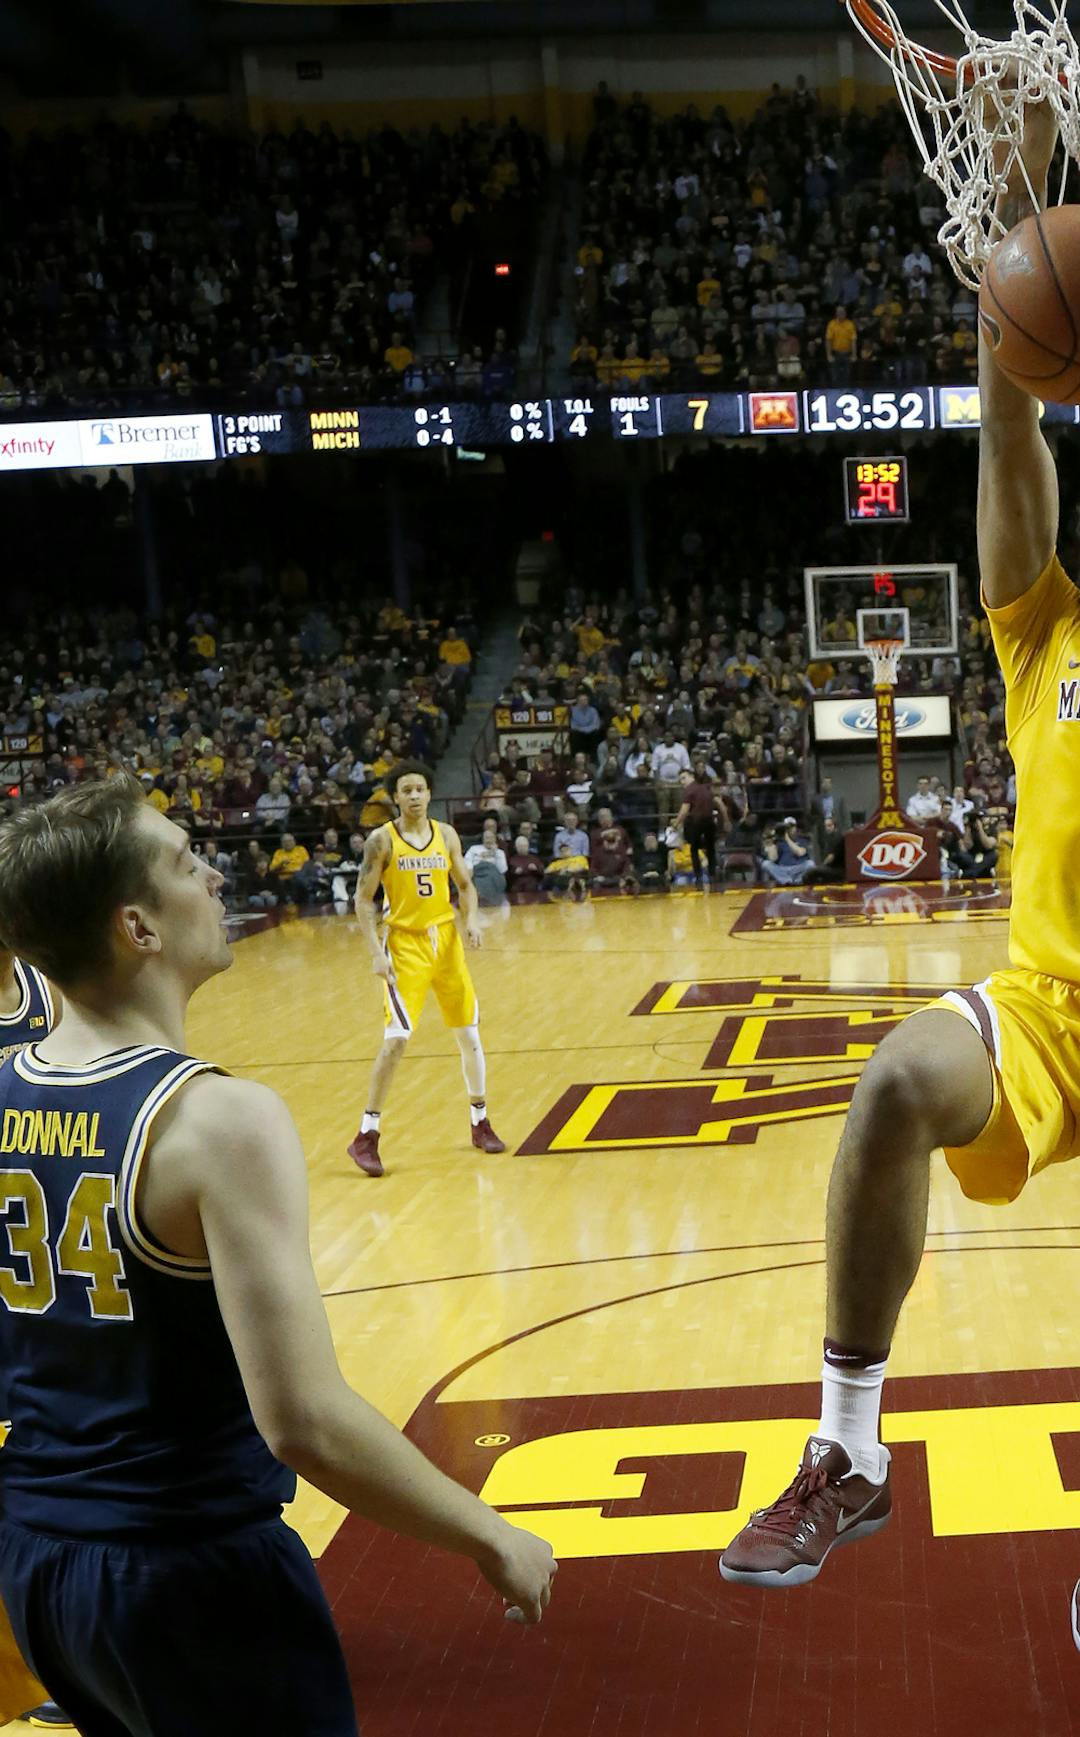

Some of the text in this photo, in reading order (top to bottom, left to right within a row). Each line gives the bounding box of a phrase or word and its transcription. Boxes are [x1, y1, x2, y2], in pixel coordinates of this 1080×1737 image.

[610, 396, 650, 413] FOULS
[687, 399, 710, 431] 7
[810, 392, 925, 432] 13:52
[224, 414, 283, 434] 3 POINT
[310, 411, 360, 430] MINN
[568, 412, 639, 437] 4 1
[118, 424, 200, 444] Bremer
[226, 436, 262, 455] FG'S
[312, 431, 361, 450] MICH
[0, 437, 56, 458] xfinity
[163, 442, 203, 460] Bank
[856, 463, 900, 483] 13:52
[858, 482, 896, 515] 29
[876, 693, 897, 808] MINNESOTA
[870, 842, 916, 868] DQ
[416, 872, 435, 898] 5
[1, 1108, 106, 1157] DONNAL
[0, 1168, 134, 1321] 34
